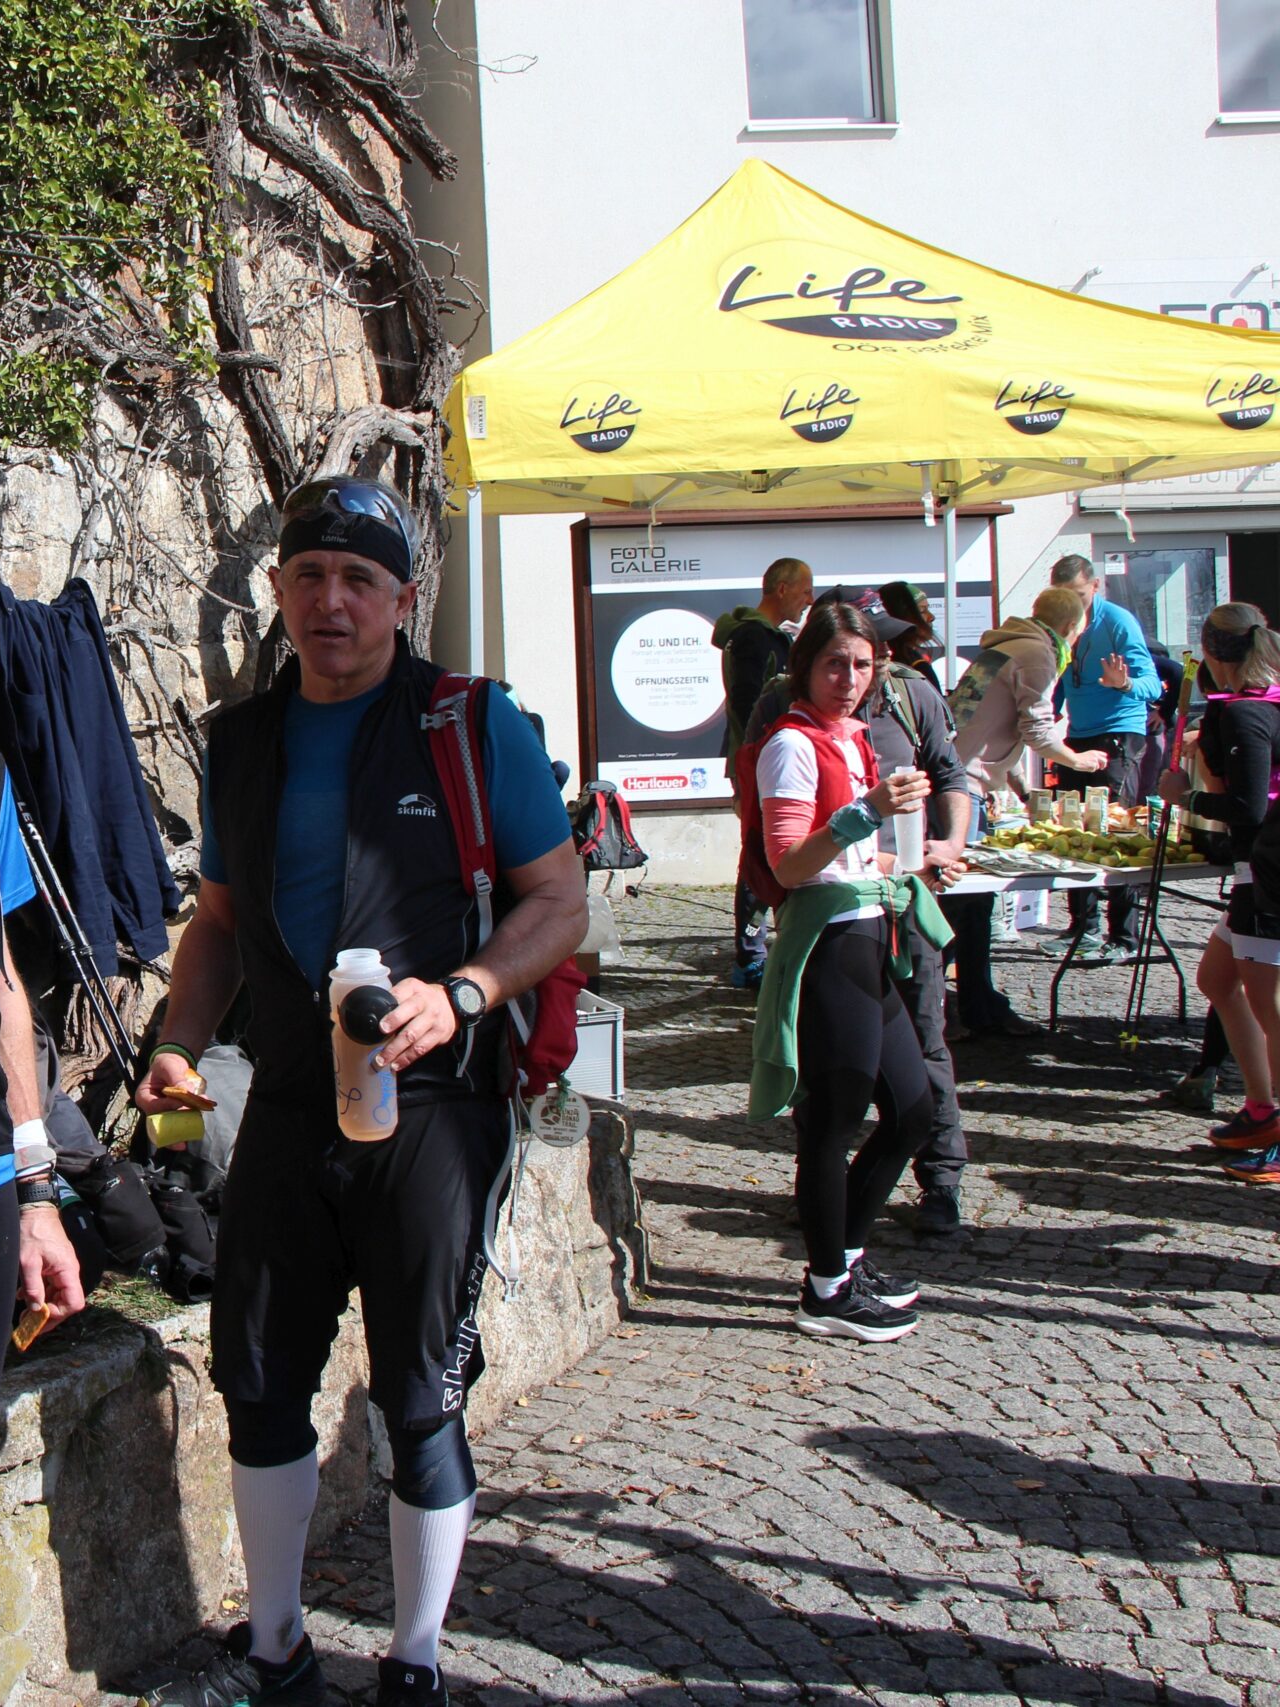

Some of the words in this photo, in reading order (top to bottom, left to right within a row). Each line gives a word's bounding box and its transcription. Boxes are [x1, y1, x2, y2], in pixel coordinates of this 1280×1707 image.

[719, 265, 963, 312] Life
[830, 315, 944, 331] RADIO
[994, 380, 1075, 412] Life
[1206, 373, 1280, 408] Life
[780, 383, 860, 420] Life
[559, 393, 642, 429] Life
[1024, 411, 1060, 425] RADIO
[1236, 407, 1271, 421] RADIO
[811, 418, 847, 433] RADIO
[591, 428, 629, 443] RADIO
[610, 546, 666, 560] FOTO
[611, 559, 701, 574] GALERIE
[639, 638, 656, 648] DU.
[658, 637, 680, 647] UND
[635, 676, 709, 686] ÖFFNUNGSZEITEN
[627, 776, 685, 790] Hartlauer
[397, 806, 436, 817] skinfit
